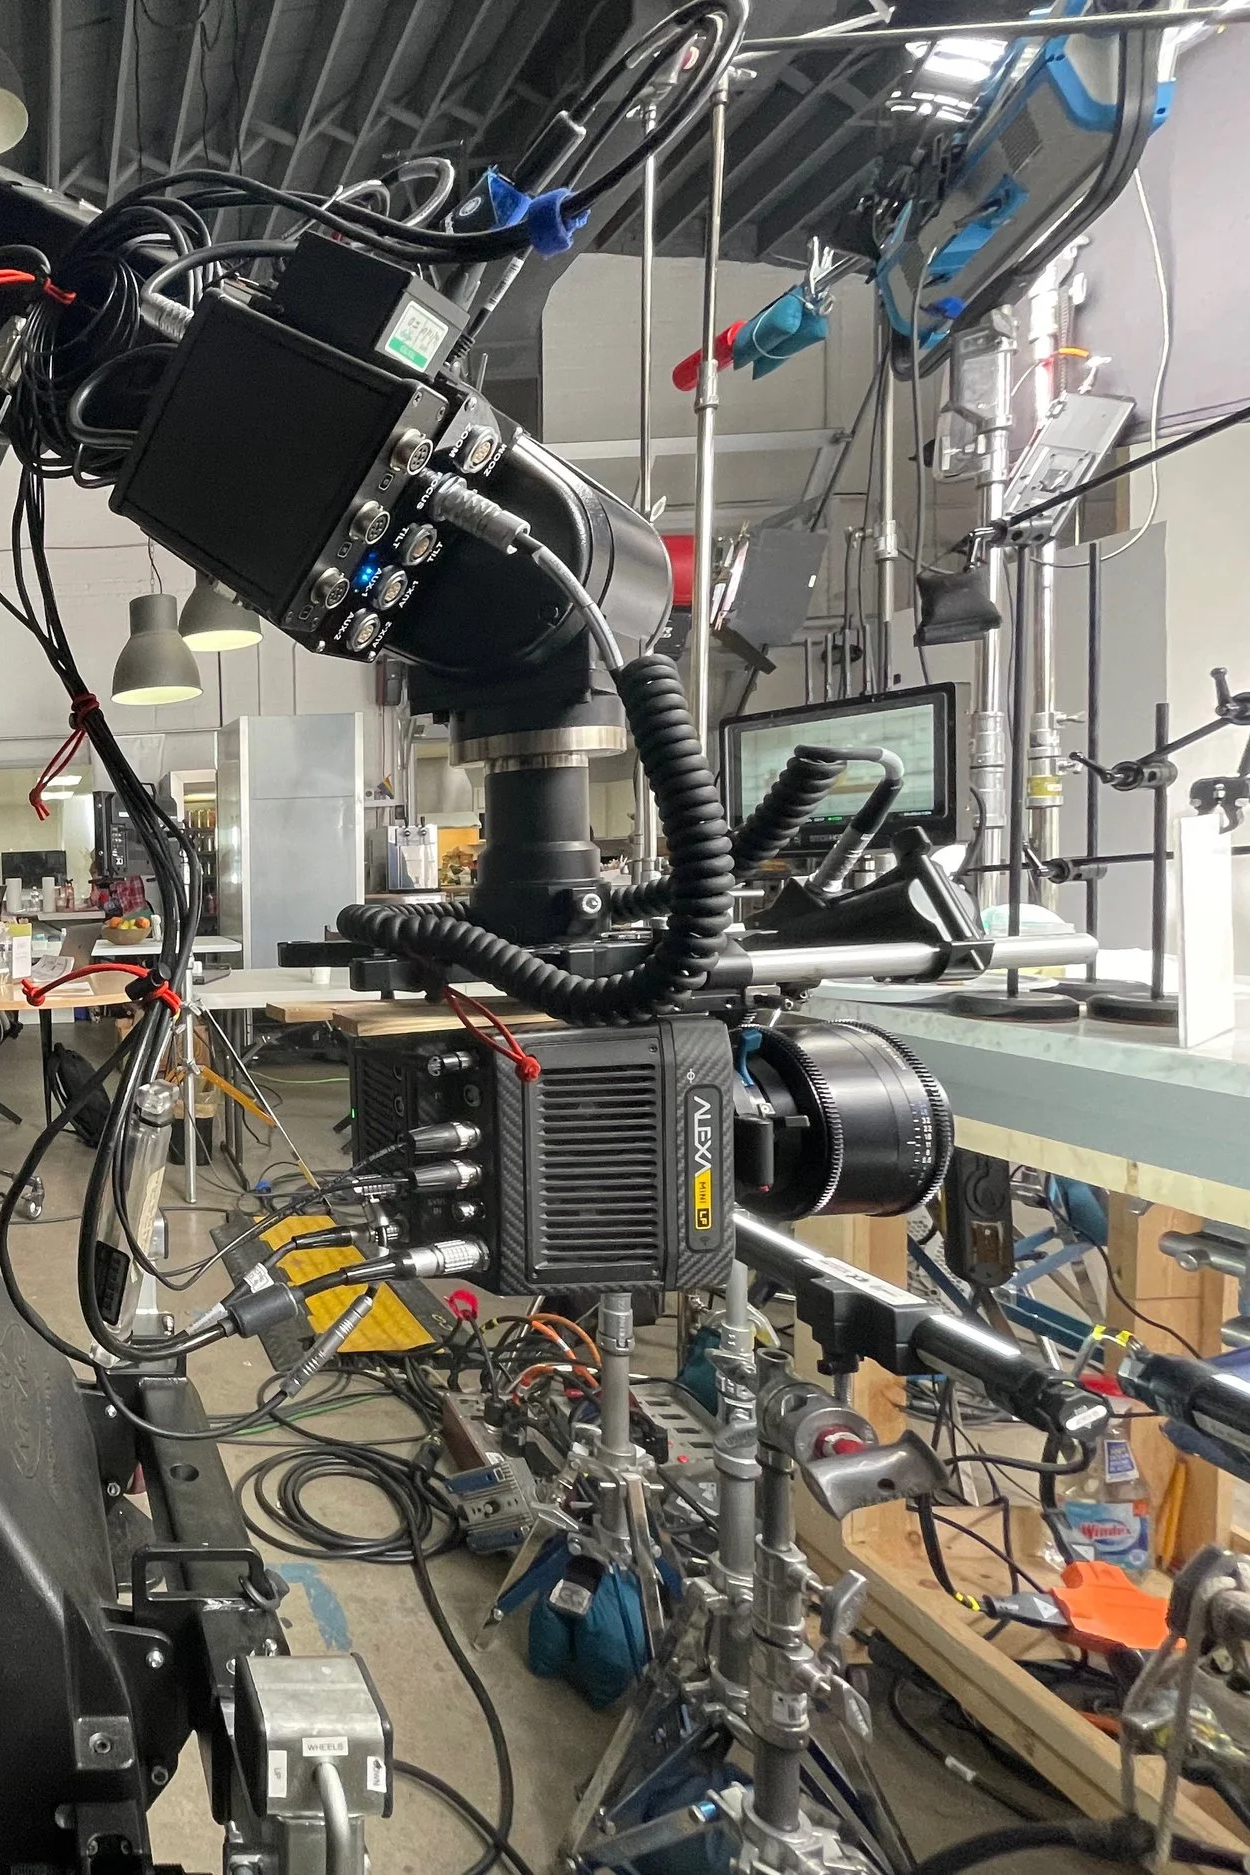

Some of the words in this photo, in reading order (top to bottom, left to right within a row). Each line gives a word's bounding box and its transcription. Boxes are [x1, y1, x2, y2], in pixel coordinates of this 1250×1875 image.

[450, 423, 472, 458] ZOOM
[484, 443, 508, 477] ZOOM
[393, 527, 410, 549] TILT
[427, 541, 444, 563] TILT
[362, 567, 382, 597] AUX-1
[398, 580, 419, 609] AUX-1
[334, 612, 354, 641] AUX-2
[372, 621, 392, 649] AUX-2
[693, 1095, 712, 1178] ALEXA
[699, 1181, 707, 1204] MINI
[699, 1210, 708, 1225] LF
[1079, 1521, 1132, 1539] Windex
[307, 1743, 343, 1751] WHEELS
